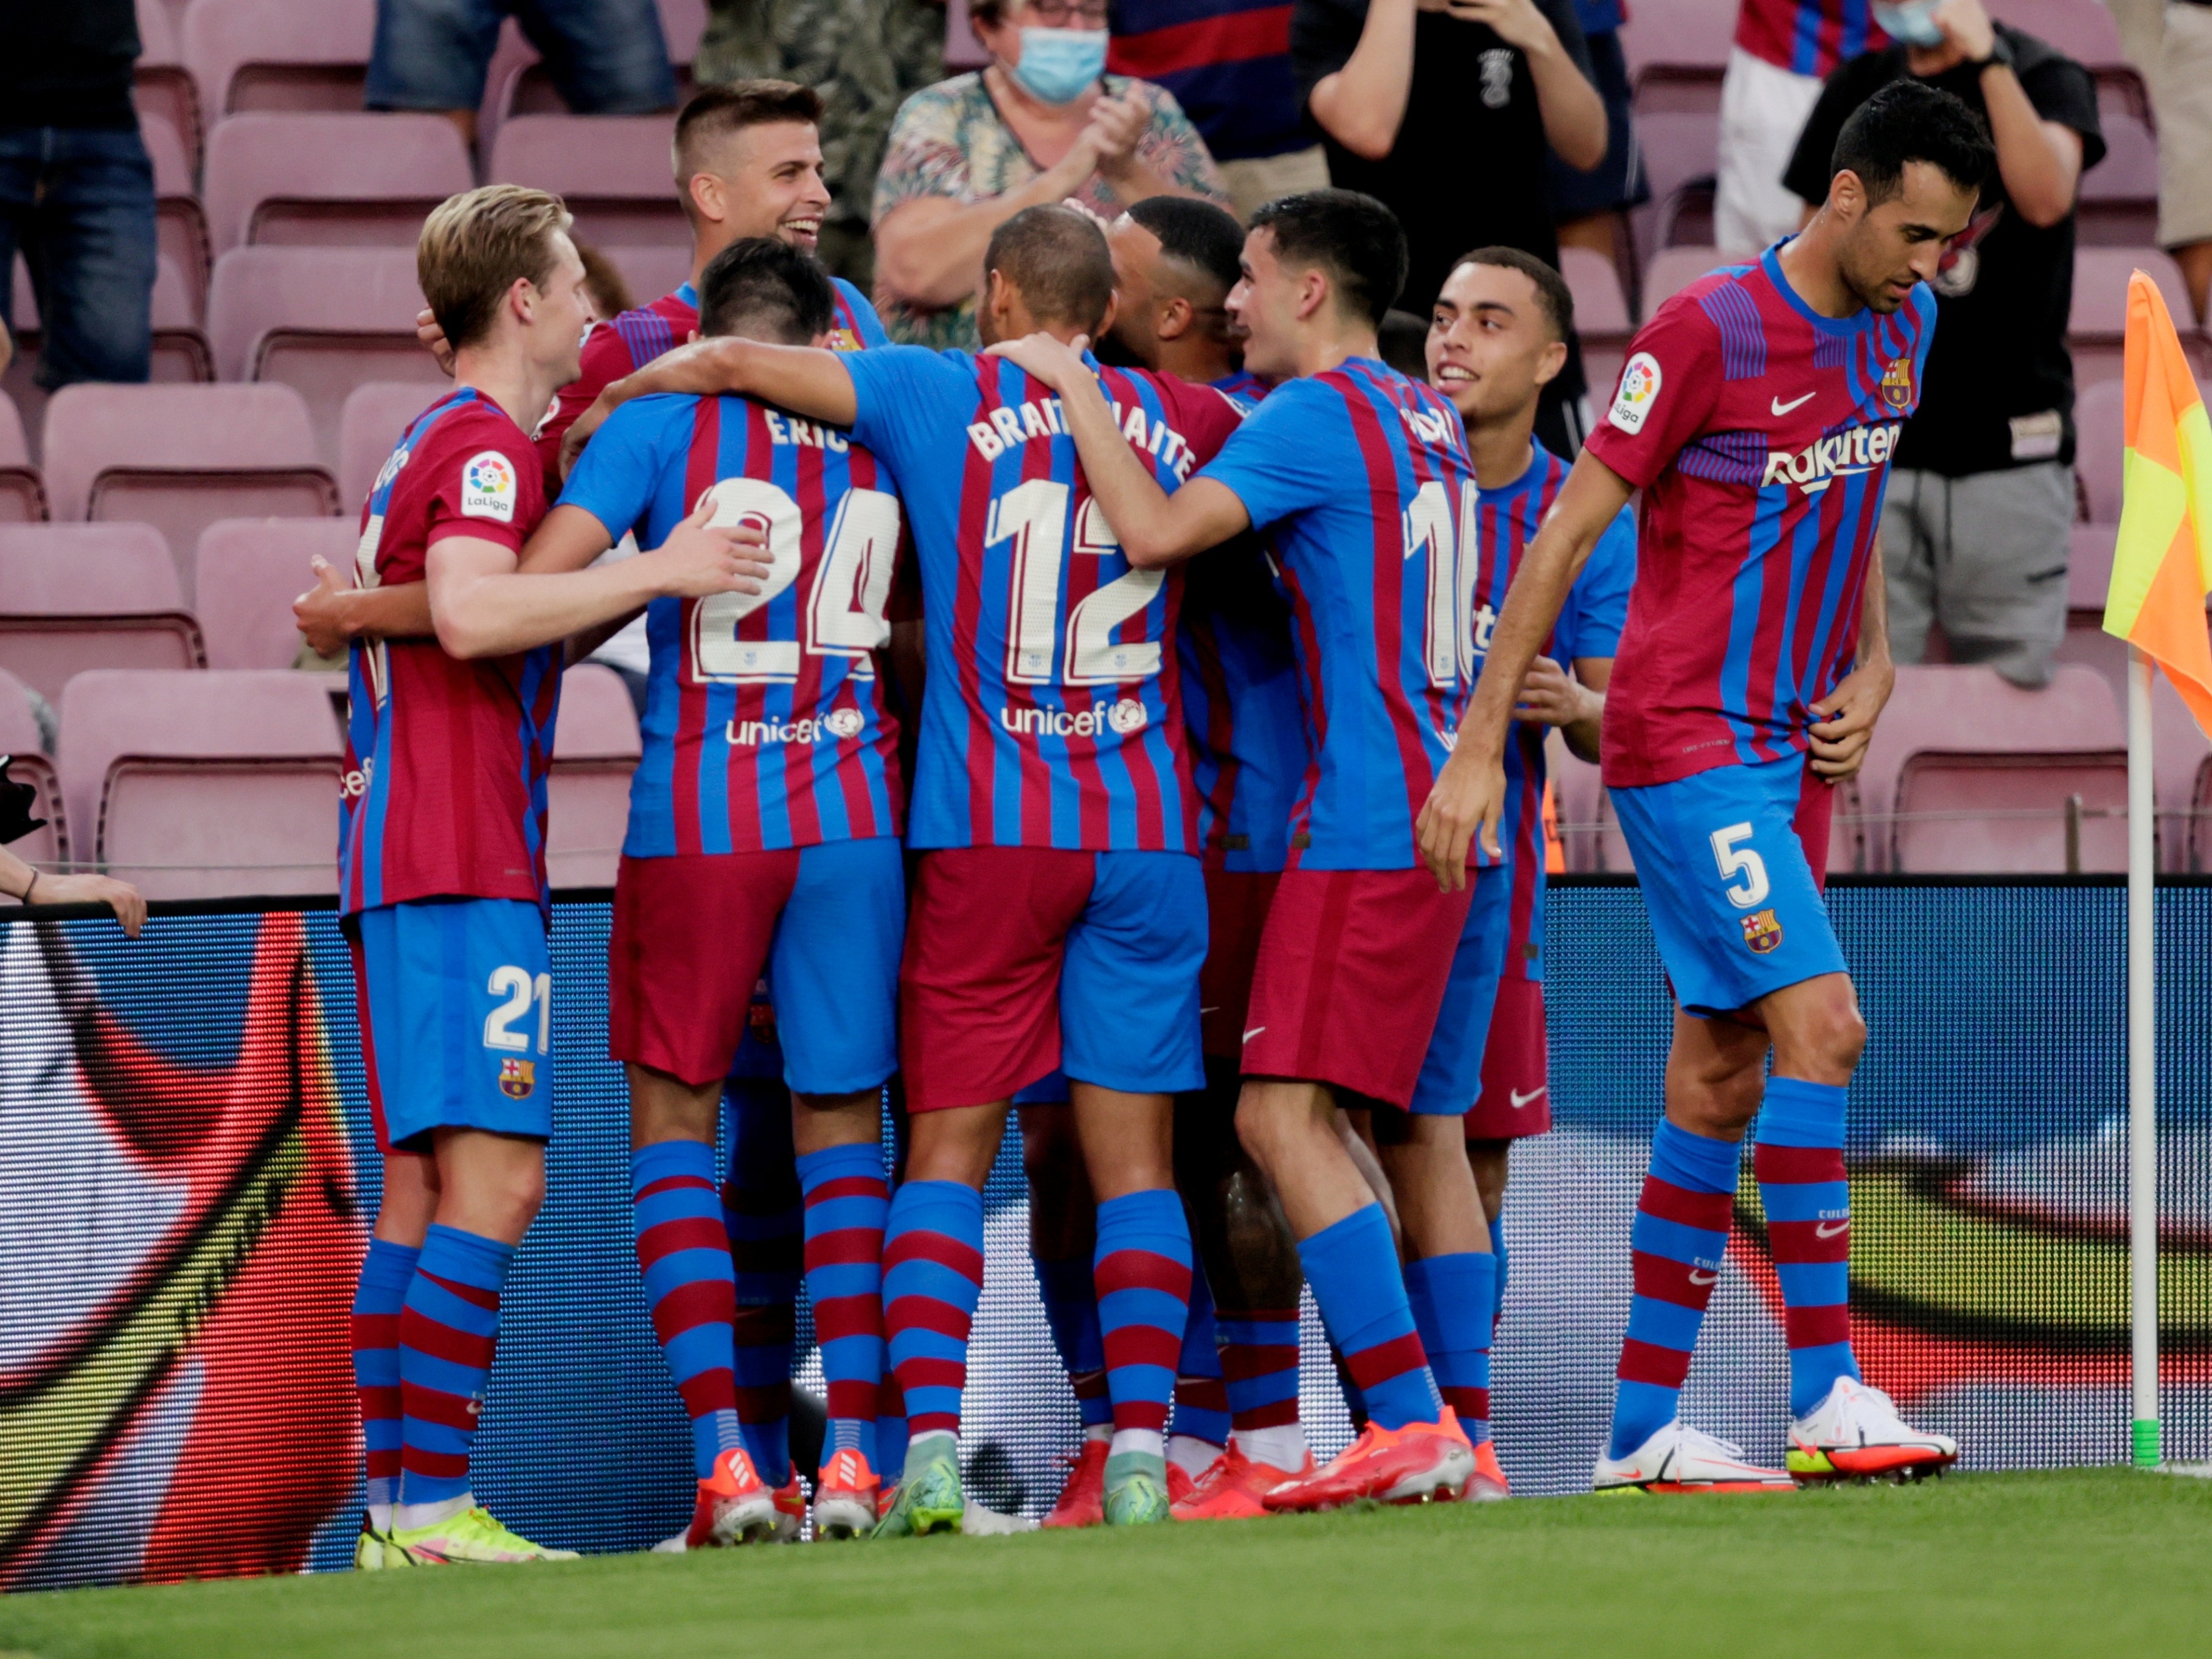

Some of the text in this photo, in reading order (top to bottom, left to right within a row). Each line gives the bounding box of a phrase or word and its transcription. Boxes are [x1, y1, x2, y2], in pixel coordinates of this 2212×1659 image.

[966, 397, 1197, 485] BRAITAITE
[467, 495, 509, 512] LaLiga
[690, 477, 900, 683] 24
[985, 479, 1166, 686] 12
[725, 712, 826, 746] unicef
[1001, 700, 1105, 736] unicef
[1709, 821, 1770, 909] 5
[483, 965, 552, 1056] 21
